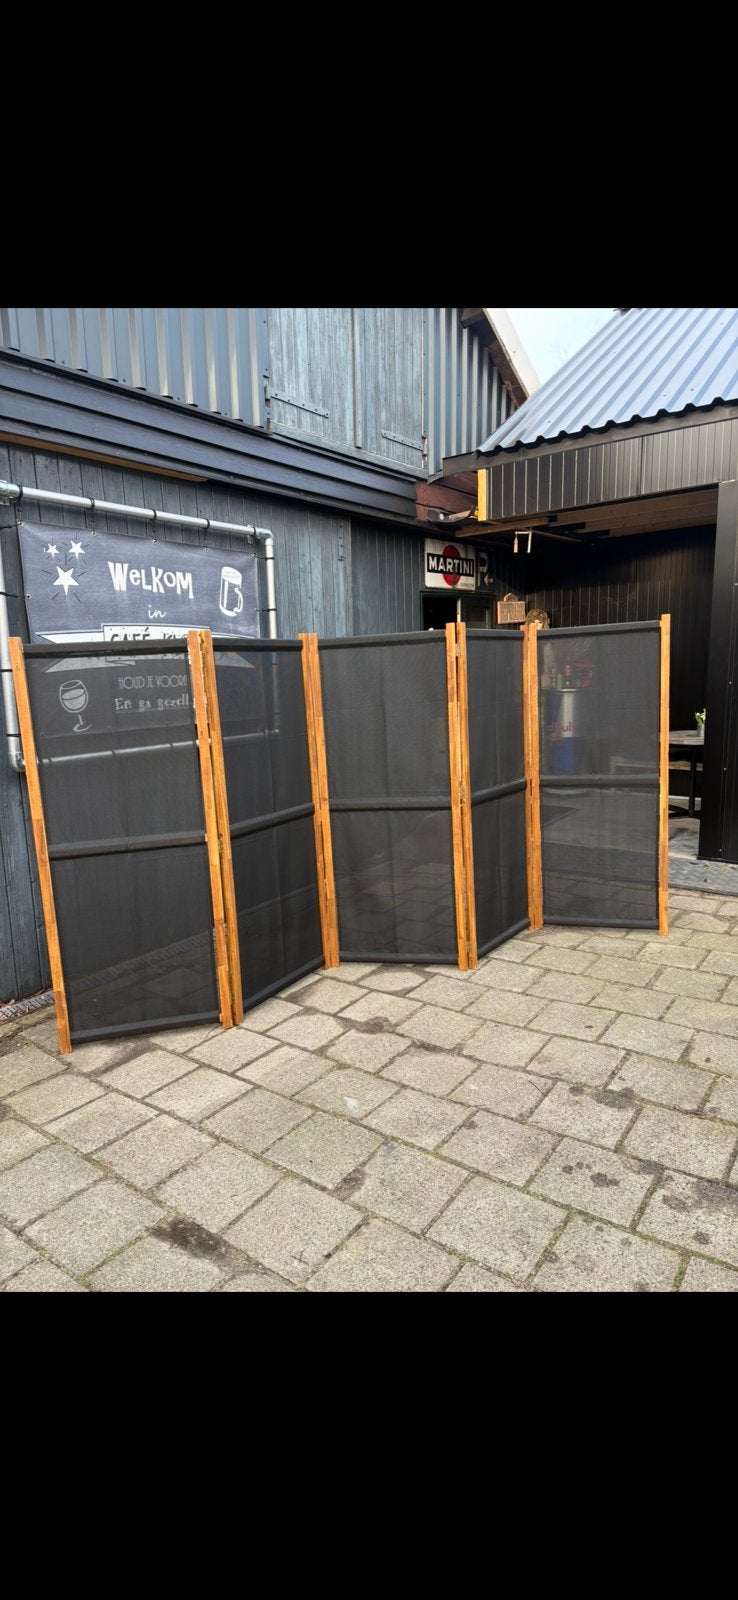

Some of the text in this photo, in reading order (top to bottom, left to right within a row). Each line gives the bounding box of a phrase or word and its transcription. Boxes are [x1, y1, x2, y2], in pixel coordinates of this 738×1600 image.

[428, 555, 473, 575] MARTINI
[147, 604, 167, 619] in
[118, 675, 145, 690] HOUD
[138, 699, 152, 713] ga
